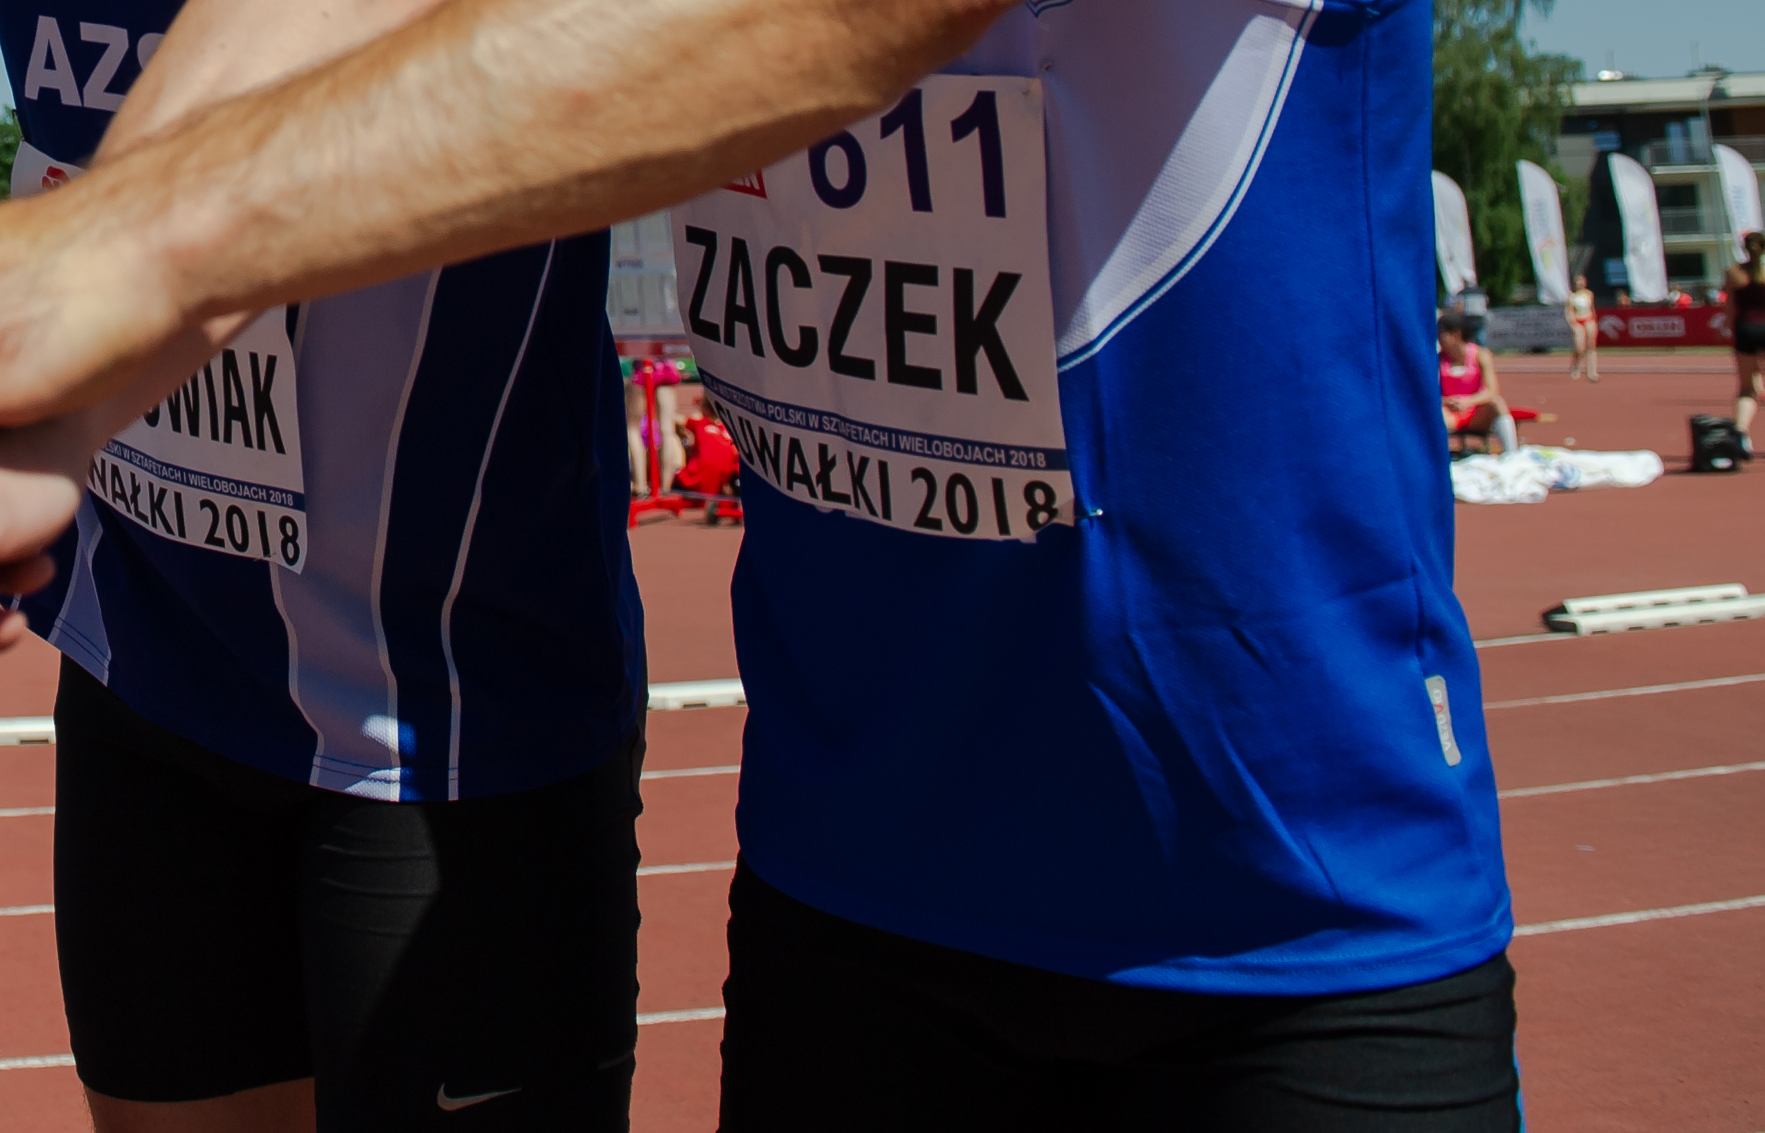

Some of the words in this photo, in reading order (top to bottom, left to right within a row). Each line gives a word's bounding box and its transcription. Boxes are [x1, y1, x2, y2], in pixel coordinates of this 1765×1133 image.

[807, 88, 1007, 219] 611
[684, 224, 1030, 402] ZACZEK
[767, 403, 807, 427] POLSKI
[808, 414, 819, 429] W
[898, 434, 1006, 465] WIELOBOJACH
[1009, 449, 1047, 468] 2018
[131, 451, 181, 485] SZTAFETACH
[188, 473, 267, 501] WIELOBOJACH
[269, 489, 294, 507] 2018
[910, 466, 1059, 536] 2018
[199, 498, 301, 567] 2018
